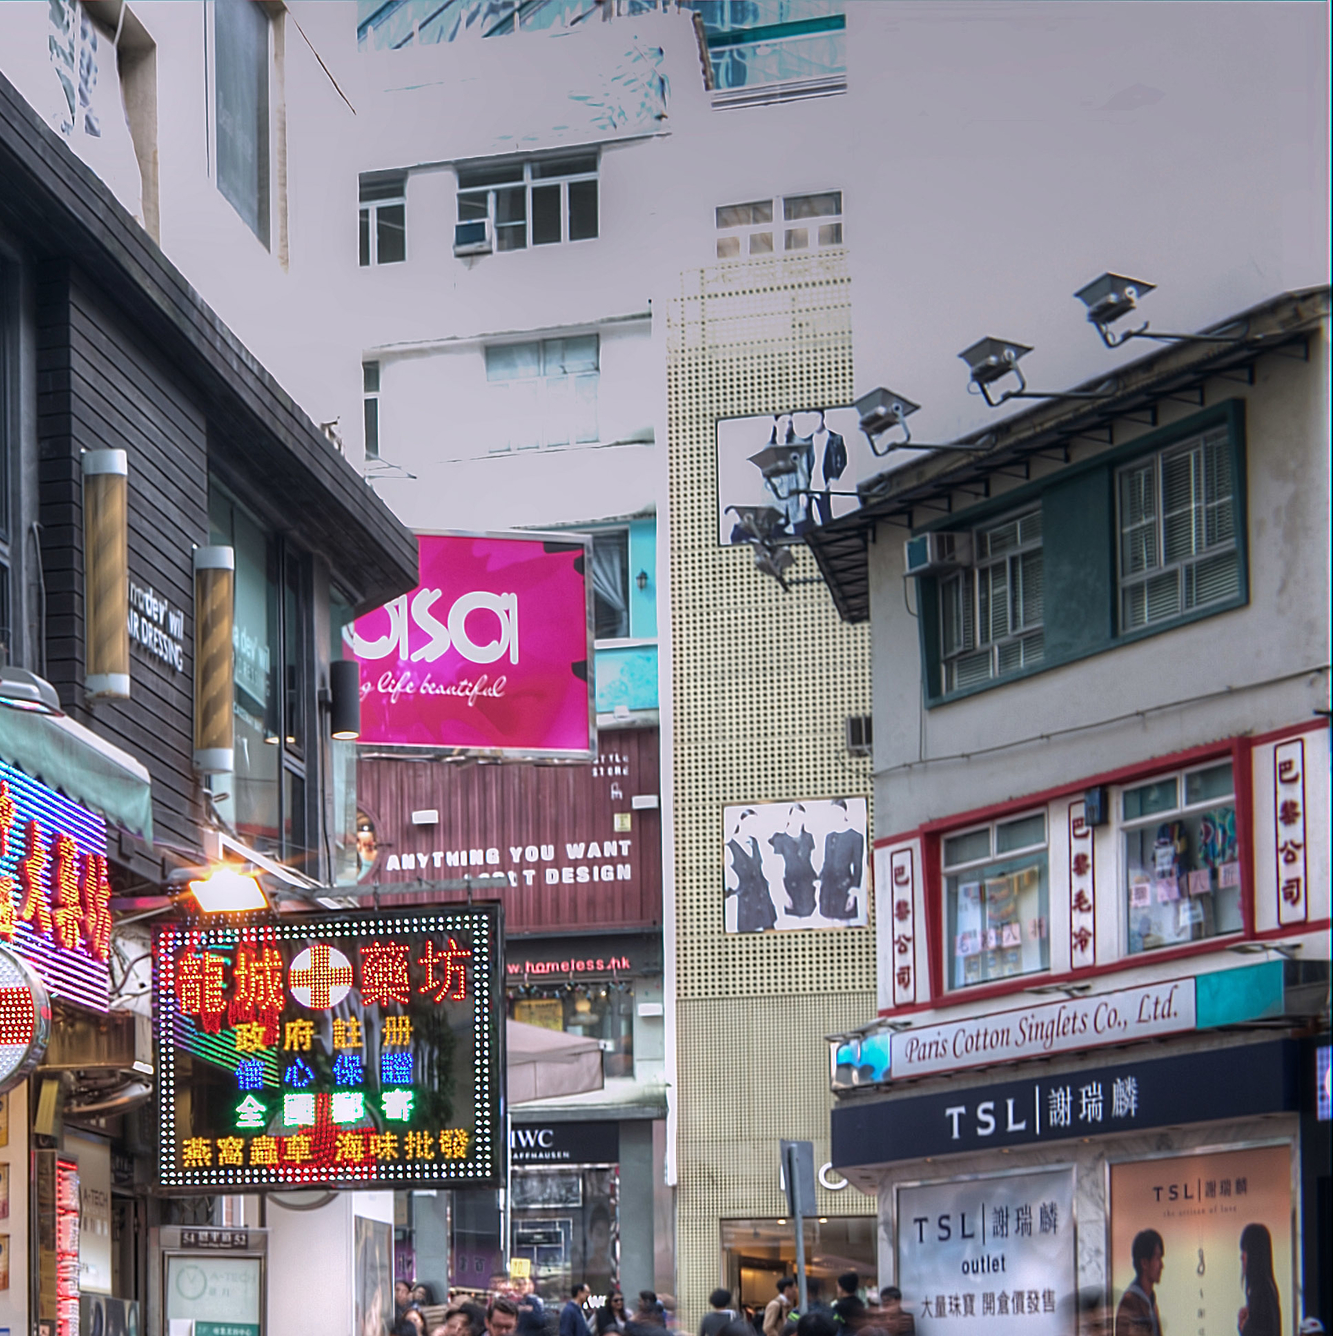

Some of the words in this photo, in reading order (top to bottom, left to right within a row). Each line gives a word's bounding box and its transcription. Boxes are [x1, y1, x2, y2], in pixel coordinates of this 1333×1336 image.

[168, 609, 184, 640] wil
[342, 588, 519, 665] asa
[141, 619, 184, 673] DRESSING
[377, 671, 416, 704] life
[420, 674, 507, 707] beautiful
[1278, 759, 1303, 907] 巴黎公司
[386, 848, 500, 871] ANYTHING
[509, 845, 555, 863] YOU
[566, 840, 632, 860] WANT
[545, 864, 632, 886] DESIGN
[893, 864, 913, 991] 巴黎公司
[178, 947, 286, 1014] 龍城
[360, 938, 472, 1007] 藥坊
[506, 956, 631, 974] w.homeless.hk
[905, 1031, 948, 1064] Paris
[952, 1025, 1011, 1059] Cotton
[1014, 1005, 1089, 1051] Singlets
[1093, 1002, 1128, 1034] Co.,
[1135, 985, 1179, 1024] Ltd.
[945, 1098, 1027, 1140] TSL
[1047, 1075, 1139, 1128] 謝瑞麟
[183, 1135, 313, 1167] 燕窩蟲草
[335, 1128, 470, 1163] 海味批發
[511, 1129, 553, 1149] IWC
[1153, 1184, 1194, 1202] TSL
[914, 1212, 975, 1243] TSL
[992, 1201, 1060, 1238] 謝瑞麟
[962, 1253, 1006, 1275] outlet
[921, 1293, 976, 1319] 大量珠寶
[982, 1288, 1056, 1316] 開倉價發售
